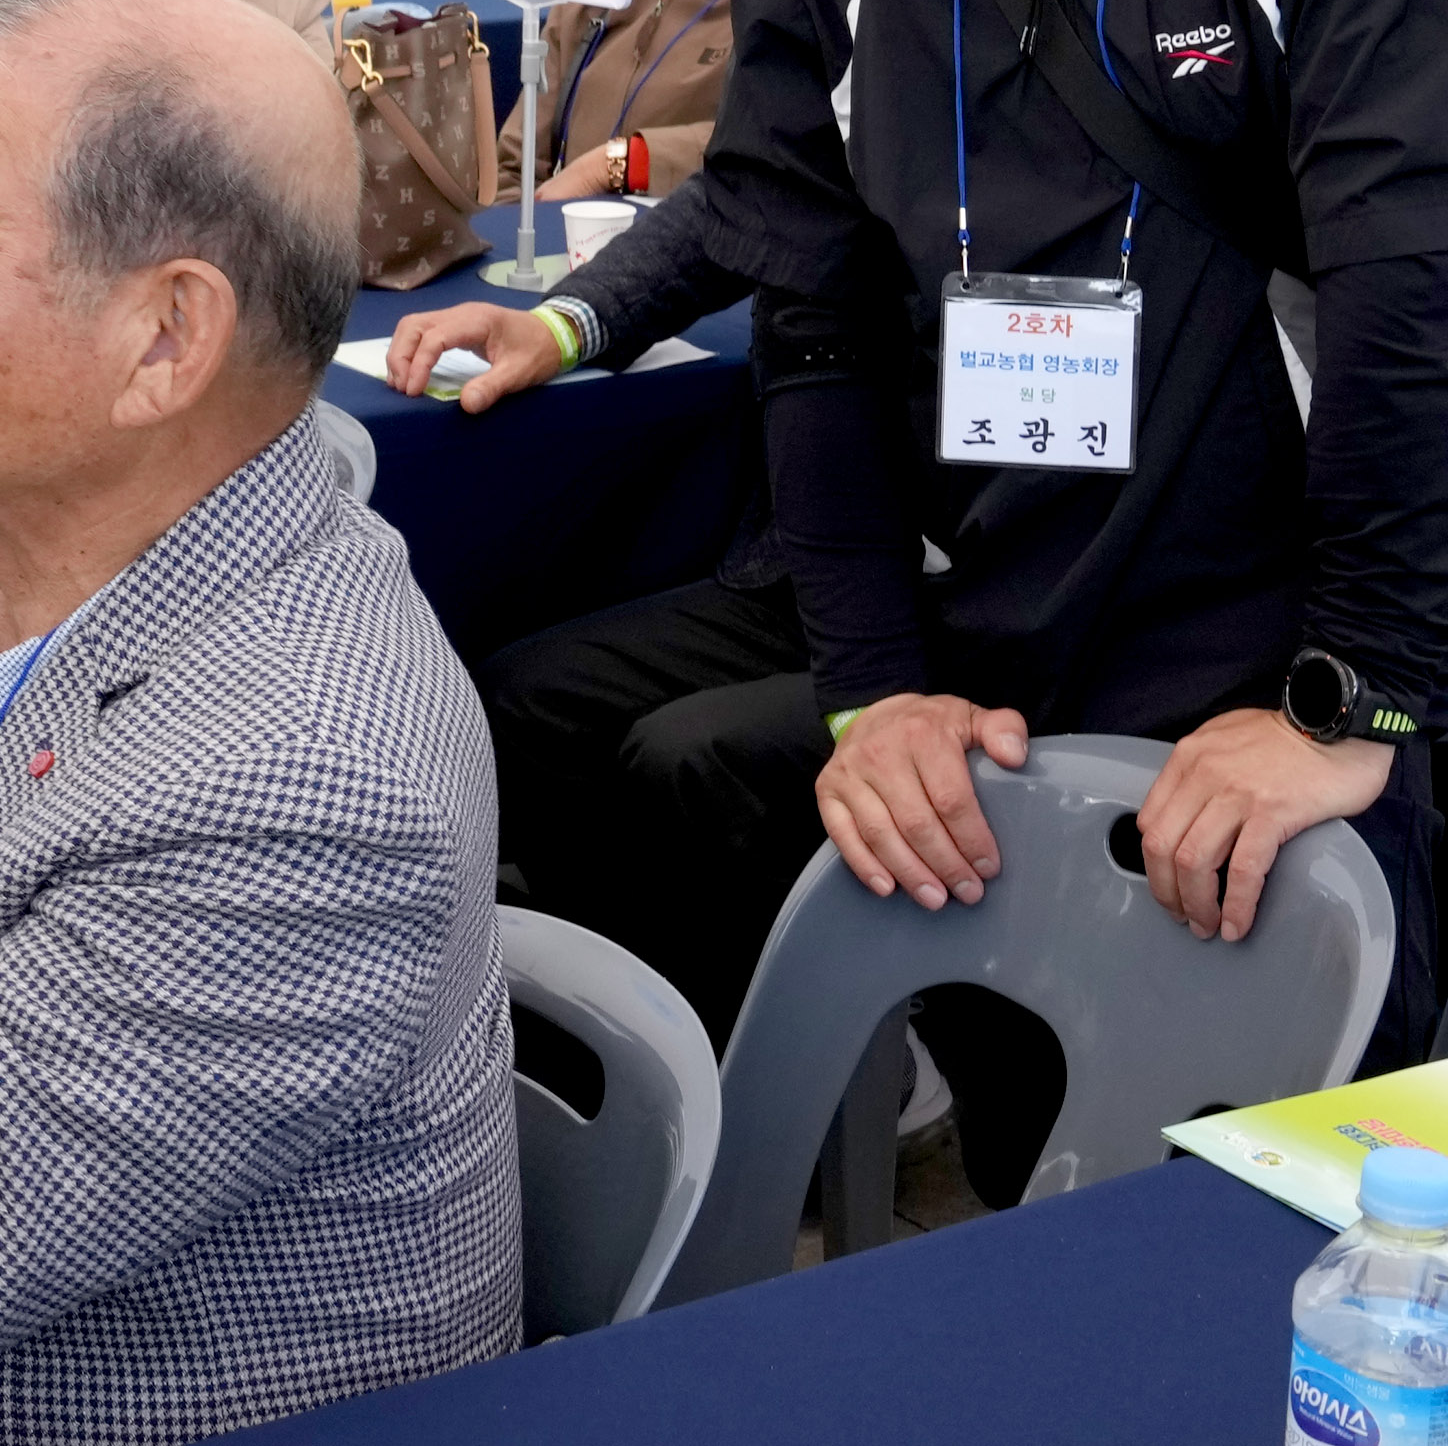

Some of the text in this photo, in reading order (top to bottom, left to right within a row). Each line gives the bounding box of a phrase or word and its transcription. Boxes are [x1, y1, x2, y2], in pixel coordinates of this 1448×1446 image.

[1155, 23, 1233, 53] Reebo
[1007, 313, 1073, 338] 2호차
[960, 350, 1119, 376] 벌교농협 영농회장
[1293, 1374, 1368, 1437] 아이시스
